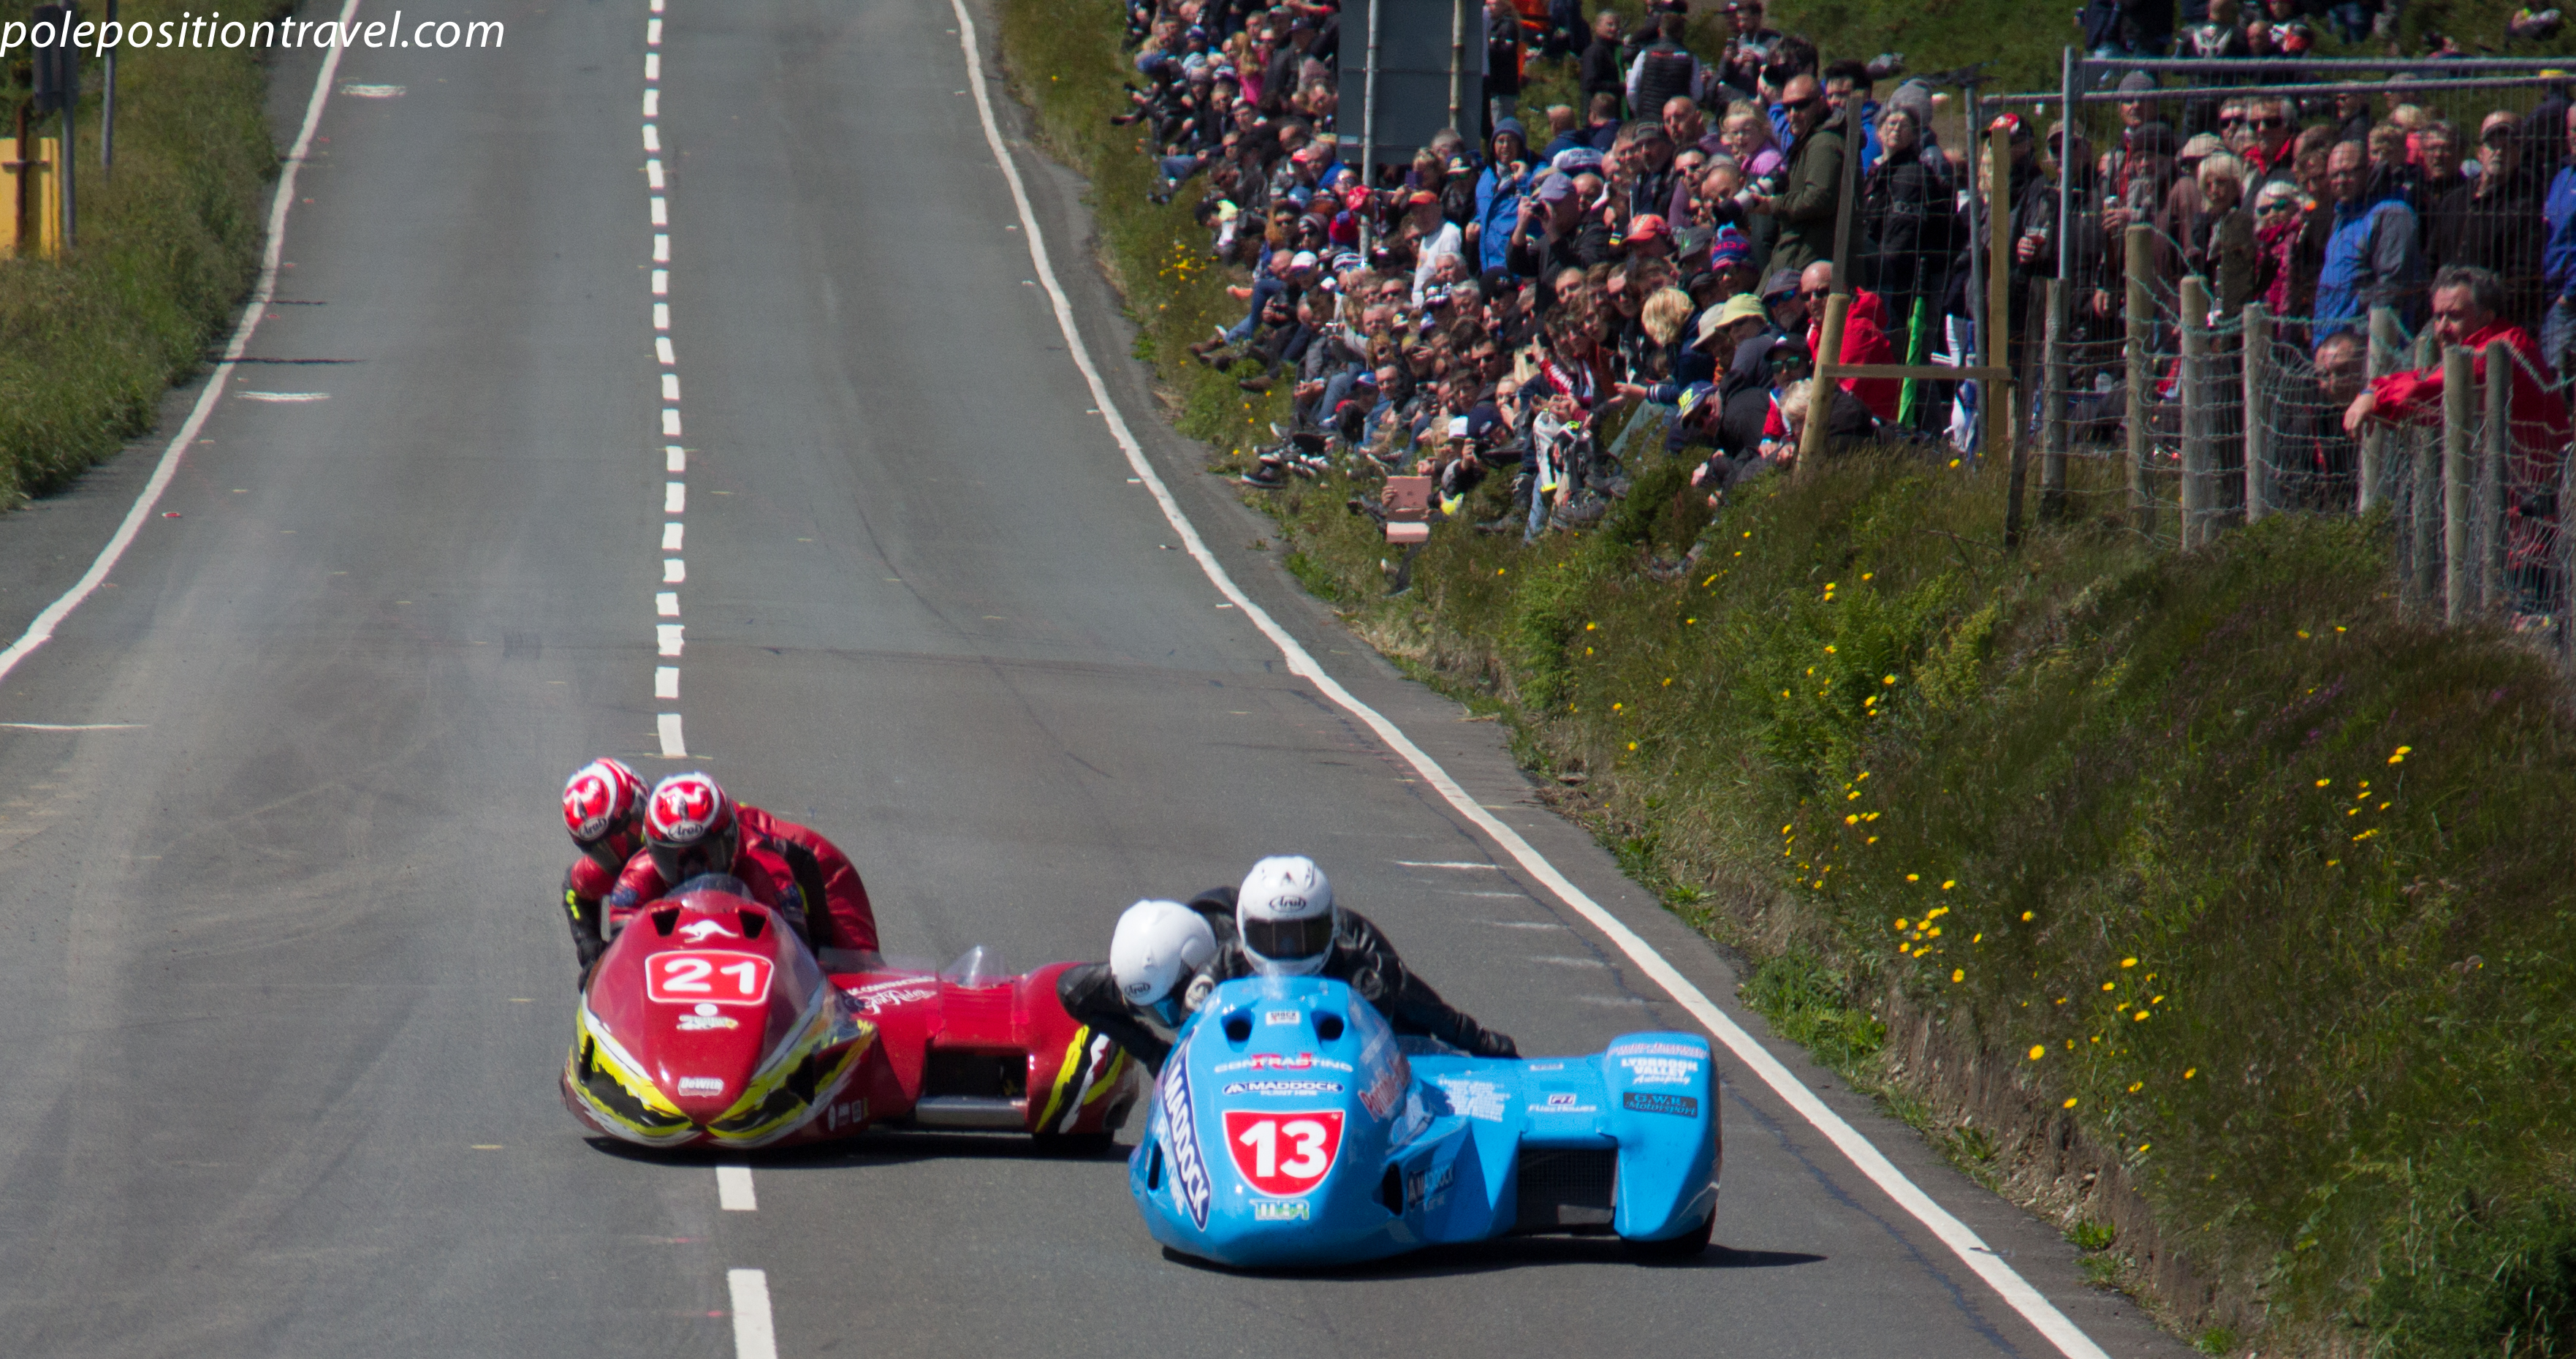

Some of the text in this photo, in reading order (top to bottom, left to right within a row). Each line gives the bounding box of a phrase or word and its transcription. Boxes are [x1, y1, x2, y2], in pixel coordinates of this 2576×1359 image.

[663, 958, 755, 994] 21
[1215, 1057, 1353, 1073] CONTRACTING
[1634, 1065, 1687, 1078] VALLEY
[1249, 1082, 1339, 1091] MADDOCK
[1165, 1061, 1208, 1222] MADDOCK
[1239, 1121, 1327, 1178] 13
